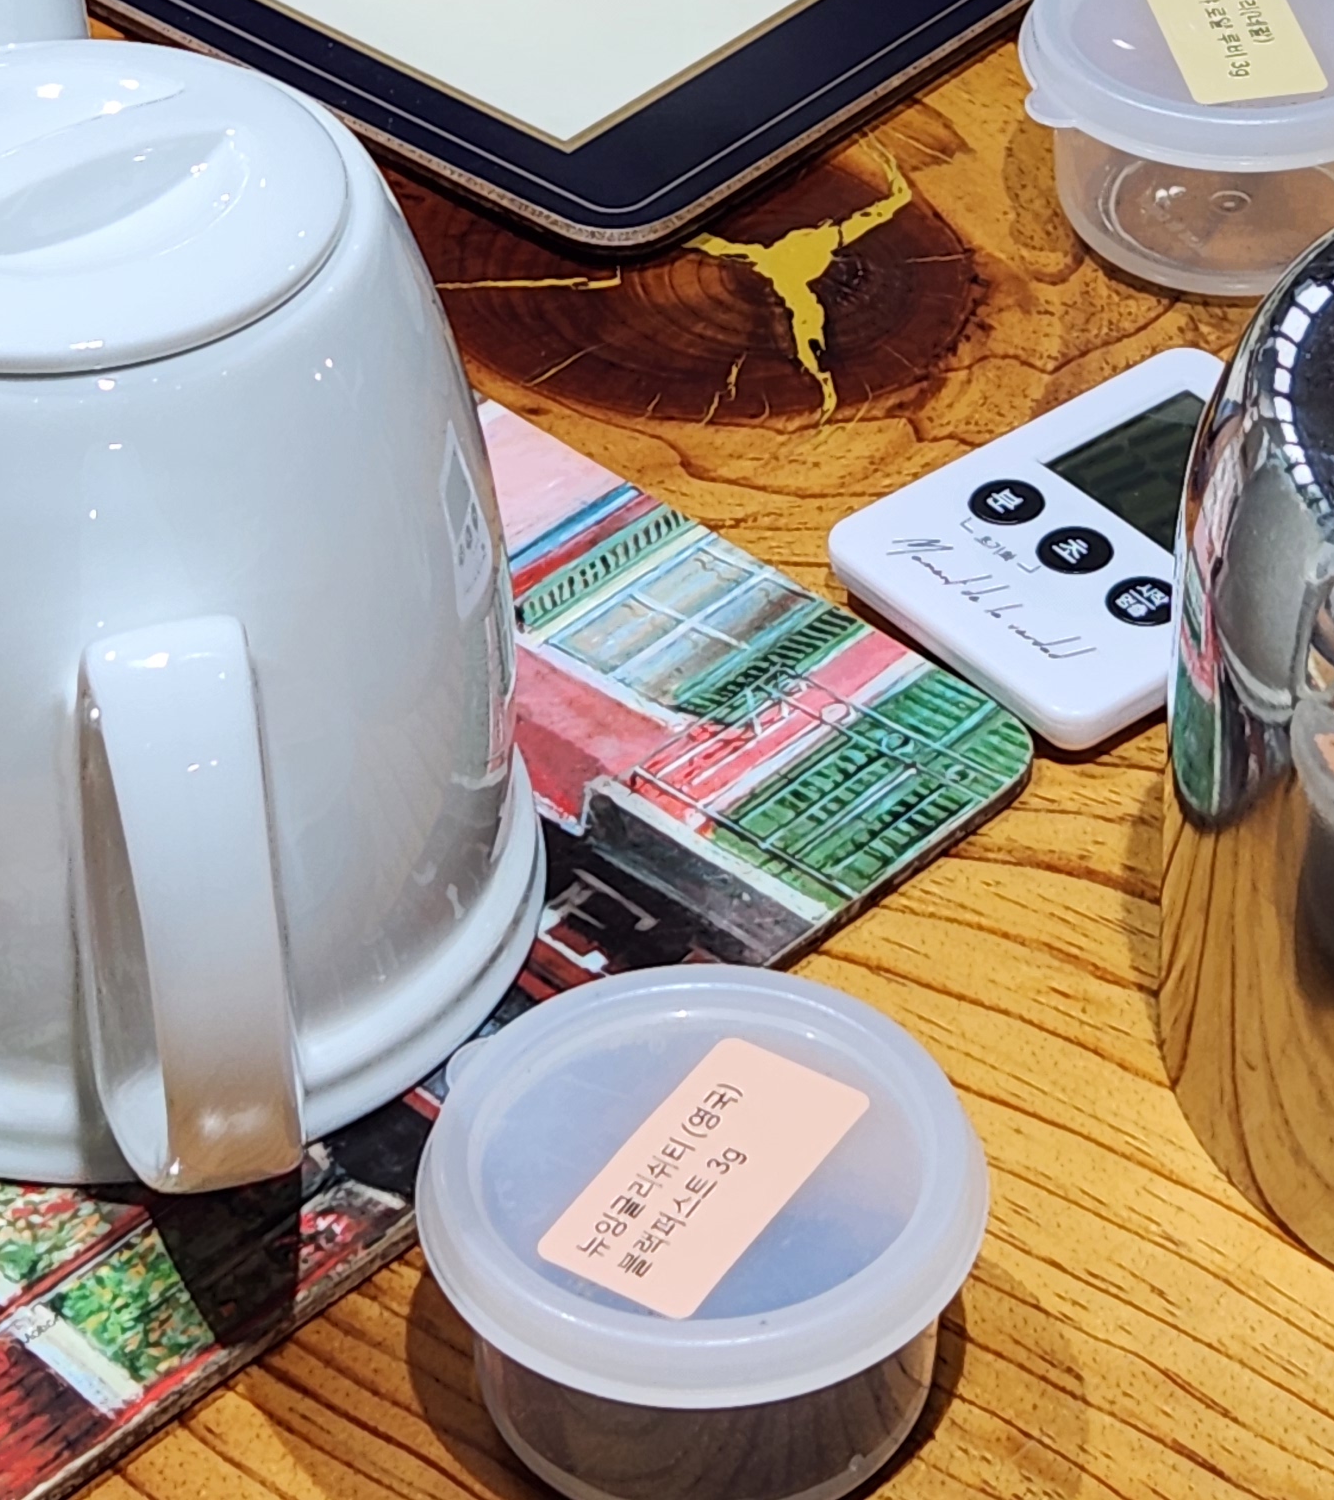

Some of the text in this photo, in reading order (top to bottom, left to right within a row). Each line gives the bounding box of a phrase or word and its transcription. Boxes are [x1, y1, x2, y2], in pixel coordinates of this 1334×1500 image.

[1217, 33, 1248, 58] 루비
[1228, 61, 1250, 77] 3g
[1052, 539, 1089, 564] 초
[576, 1083, 744, 1258] 뉴잉글리쉬티 (영국)
[617, 1147, 748, 1278] 블랙퍼스트 3g
